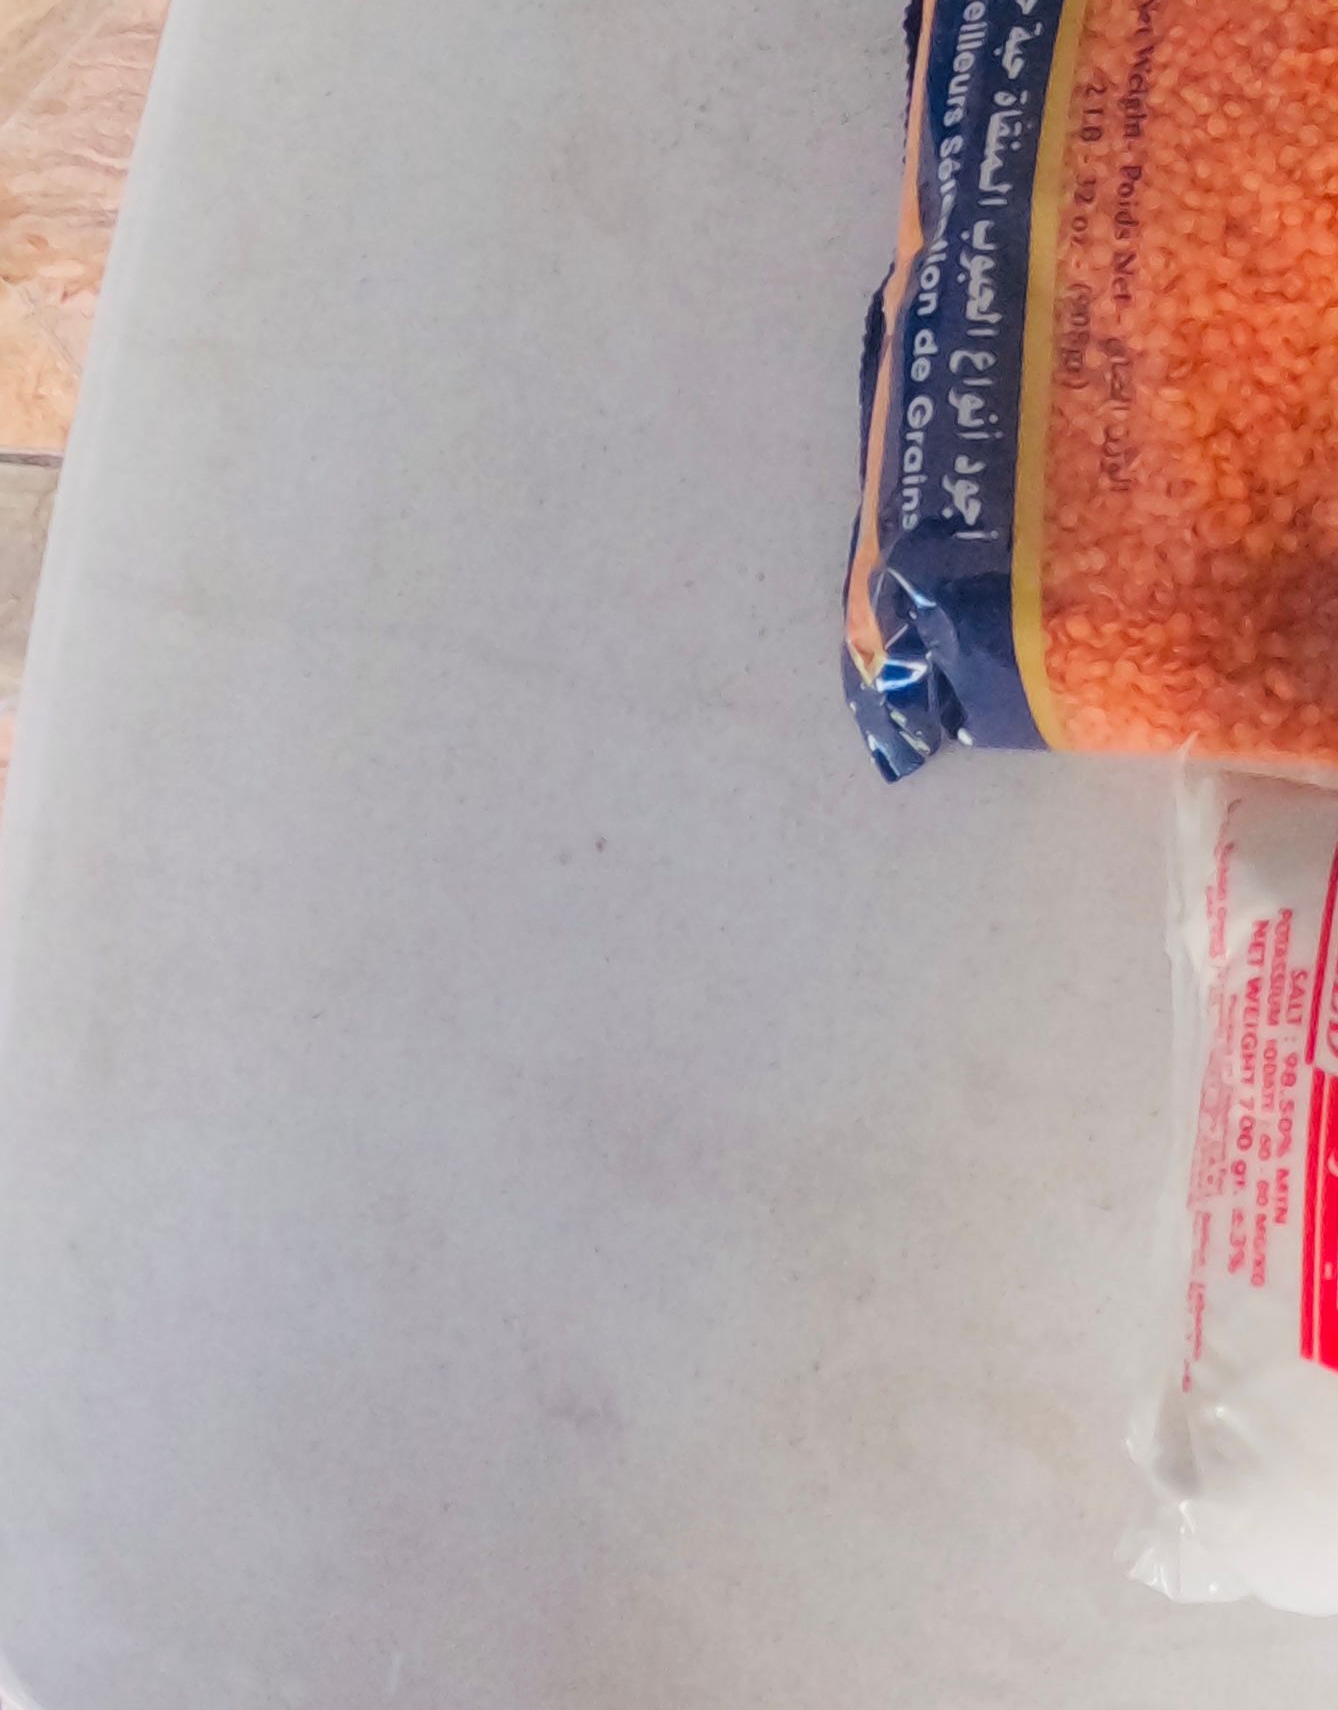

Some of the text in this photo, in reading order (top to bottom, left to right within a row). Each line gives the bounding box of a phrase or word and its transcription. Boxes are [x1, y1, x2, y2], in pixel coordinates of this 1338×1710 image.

[992, 22, 1044, 81] حبة
[1111, 164, 1144, 241] Poids
[957, 218, 1005, 337] الحبوب
[909, 329, 941, 383] de
[948, 347, 1003, 440] أنواع
[899, 394, 936, 533] Grains
[941, 453, 1001, 543] أجود
[1235, 919, 1272, 1152] NET WEIGHT 700
[1285, 970, 1310, 1026] SALT
